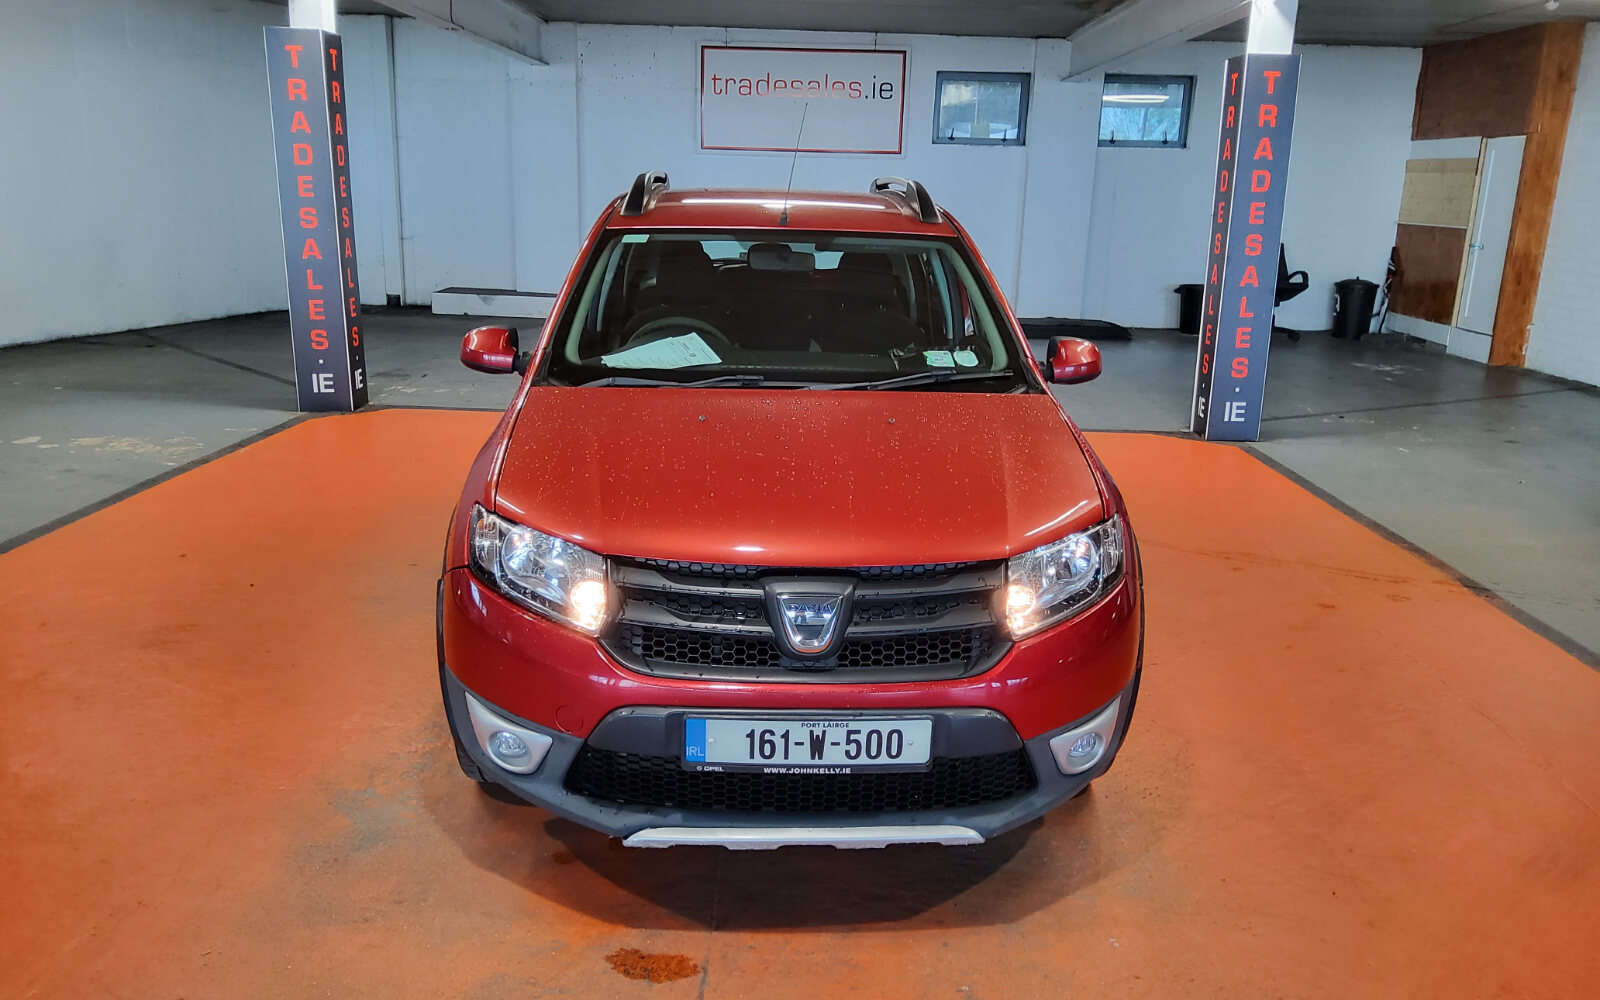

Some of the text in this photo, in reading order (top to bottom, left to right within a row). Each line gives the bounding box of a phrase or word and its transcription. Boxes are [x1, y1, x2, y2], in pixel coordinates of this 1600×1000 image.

[711, 72, 894, 100] tradesales.ie
[686, 746, 704, 757] IRL
[745, 729, 904, 760] 161-W-500
